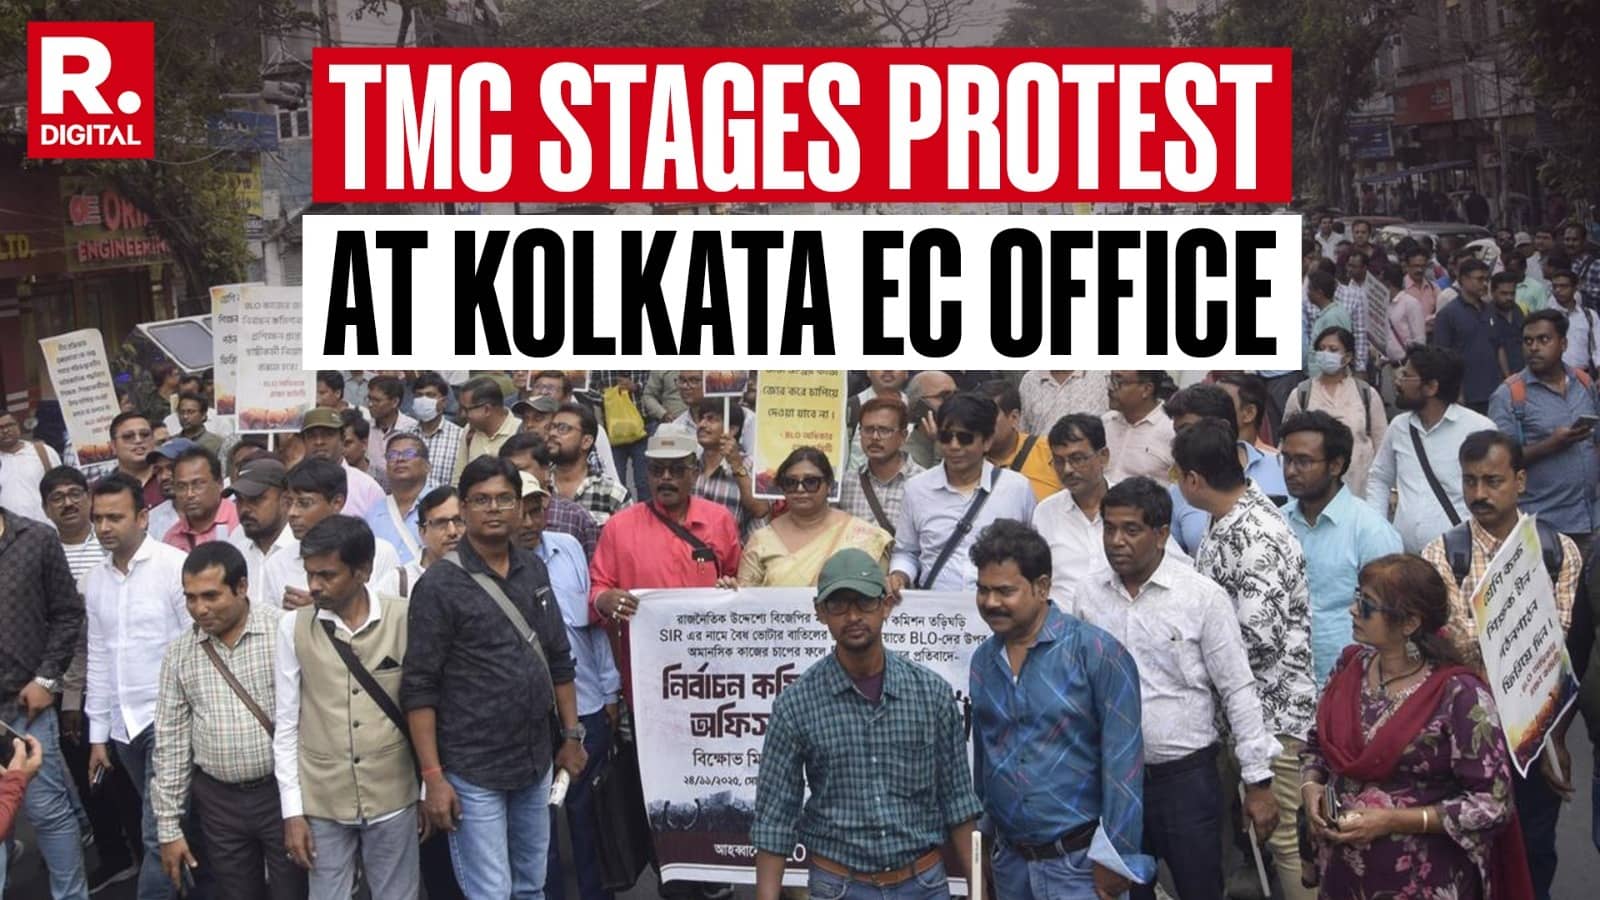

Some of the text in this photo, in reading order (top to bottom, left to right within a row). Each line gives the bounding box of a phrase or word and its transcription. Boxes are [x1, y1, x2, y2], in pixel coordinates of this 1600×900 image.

[676, 611, 727, 625] রাজনৈতিক
[771, 610, 811, 624] বিজেপির
[891, 612, 924, 627] কমিশন
[659, 629, 683, 642] SIR
[686, 629, 701, 641] এর
[705, 629, 728, 641] নামে
[752, 628, 784, 641] ভোটার
[787, 627, 828, 641] বাতিলের
[737, 646, 769, 658] কাজের
[772, 646, 801, 658] চাপের
[804, 646, 826, 658] ফলে
[662, 661, 745, 700] নির্বাচন
[692, 747, 743, 768] বিক্ষোভ
